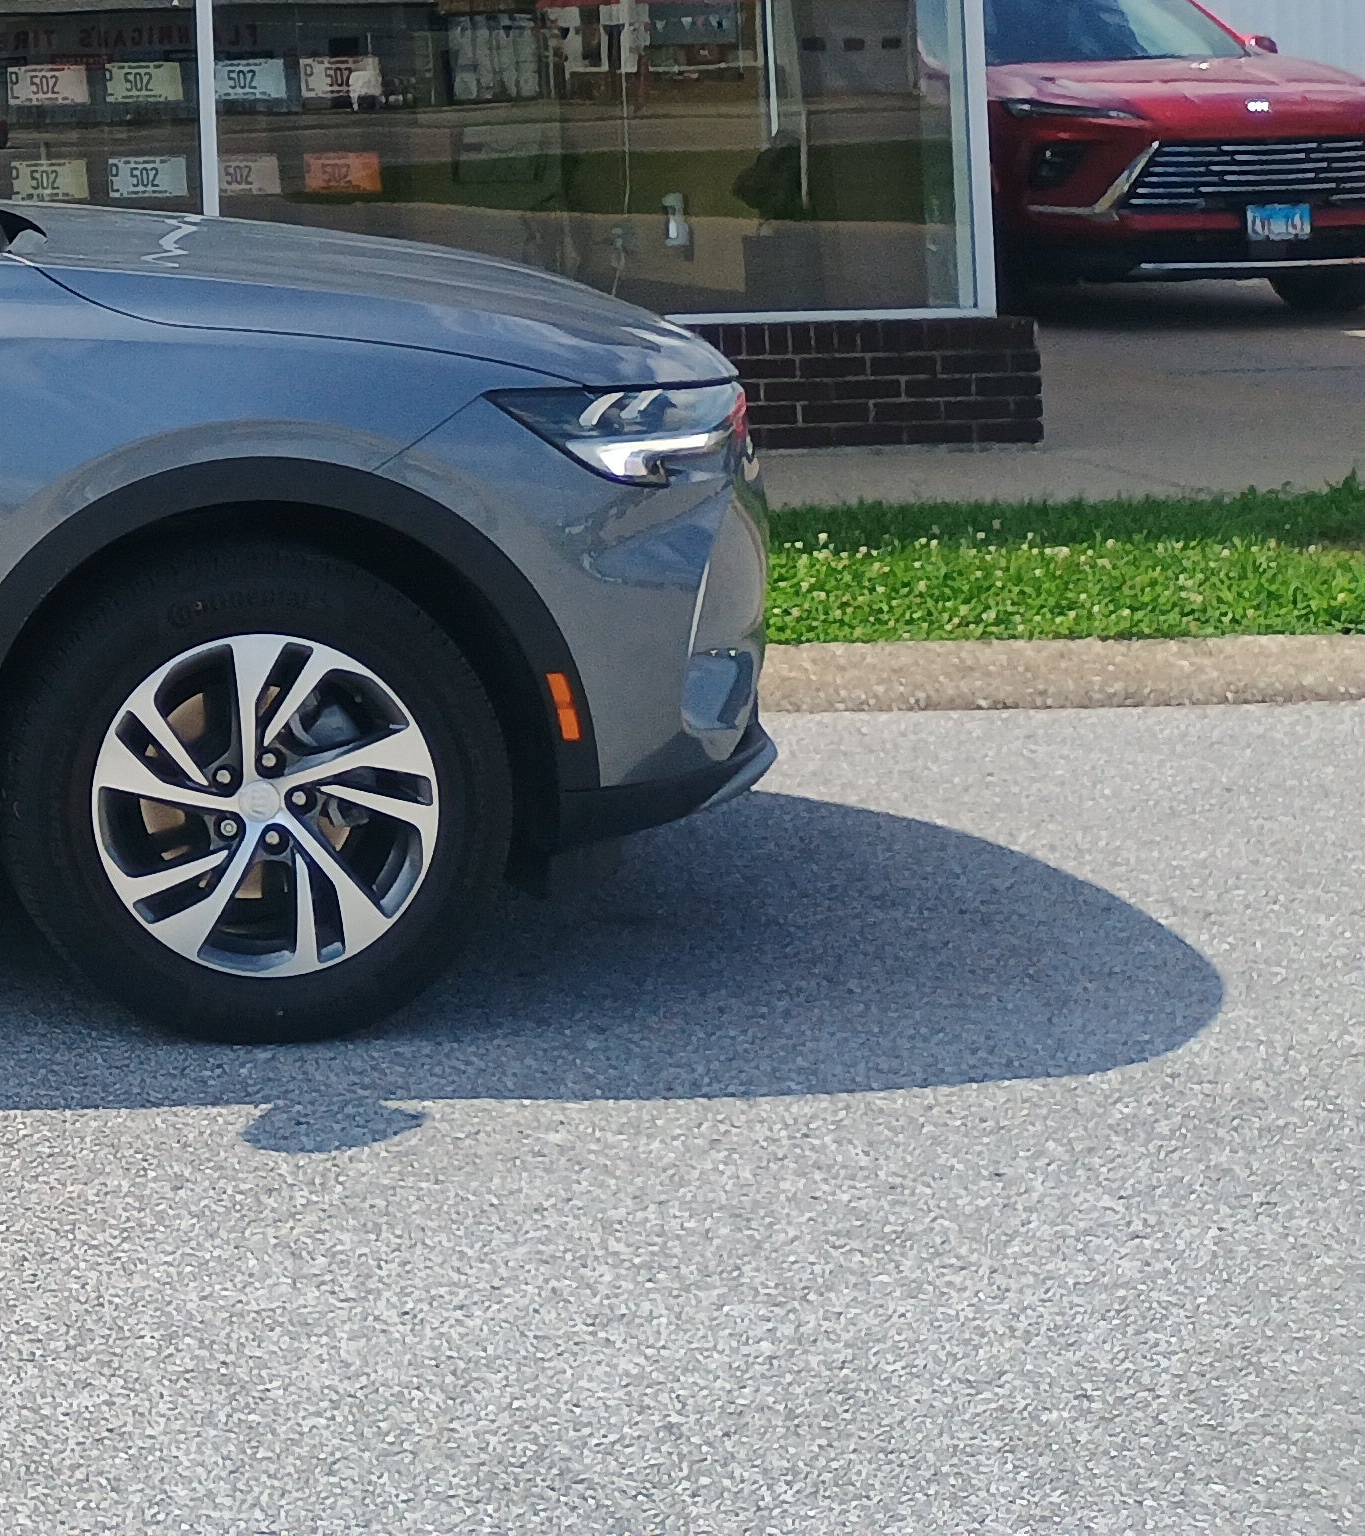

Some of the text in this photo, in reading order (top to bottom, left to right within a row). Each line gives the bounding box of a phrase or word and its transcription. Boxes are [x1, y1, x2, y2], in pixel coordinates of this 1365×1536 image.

[29, 74, 60, 95] 502
[123, 71, 154, 92] 502
[226, 68, 258, 90] 502
[324, 66, 353, 87] 502
[29, 169, 61, 190] 502
[129, 166, 160, 188] 502
[223, 164, 254, 186] 502
